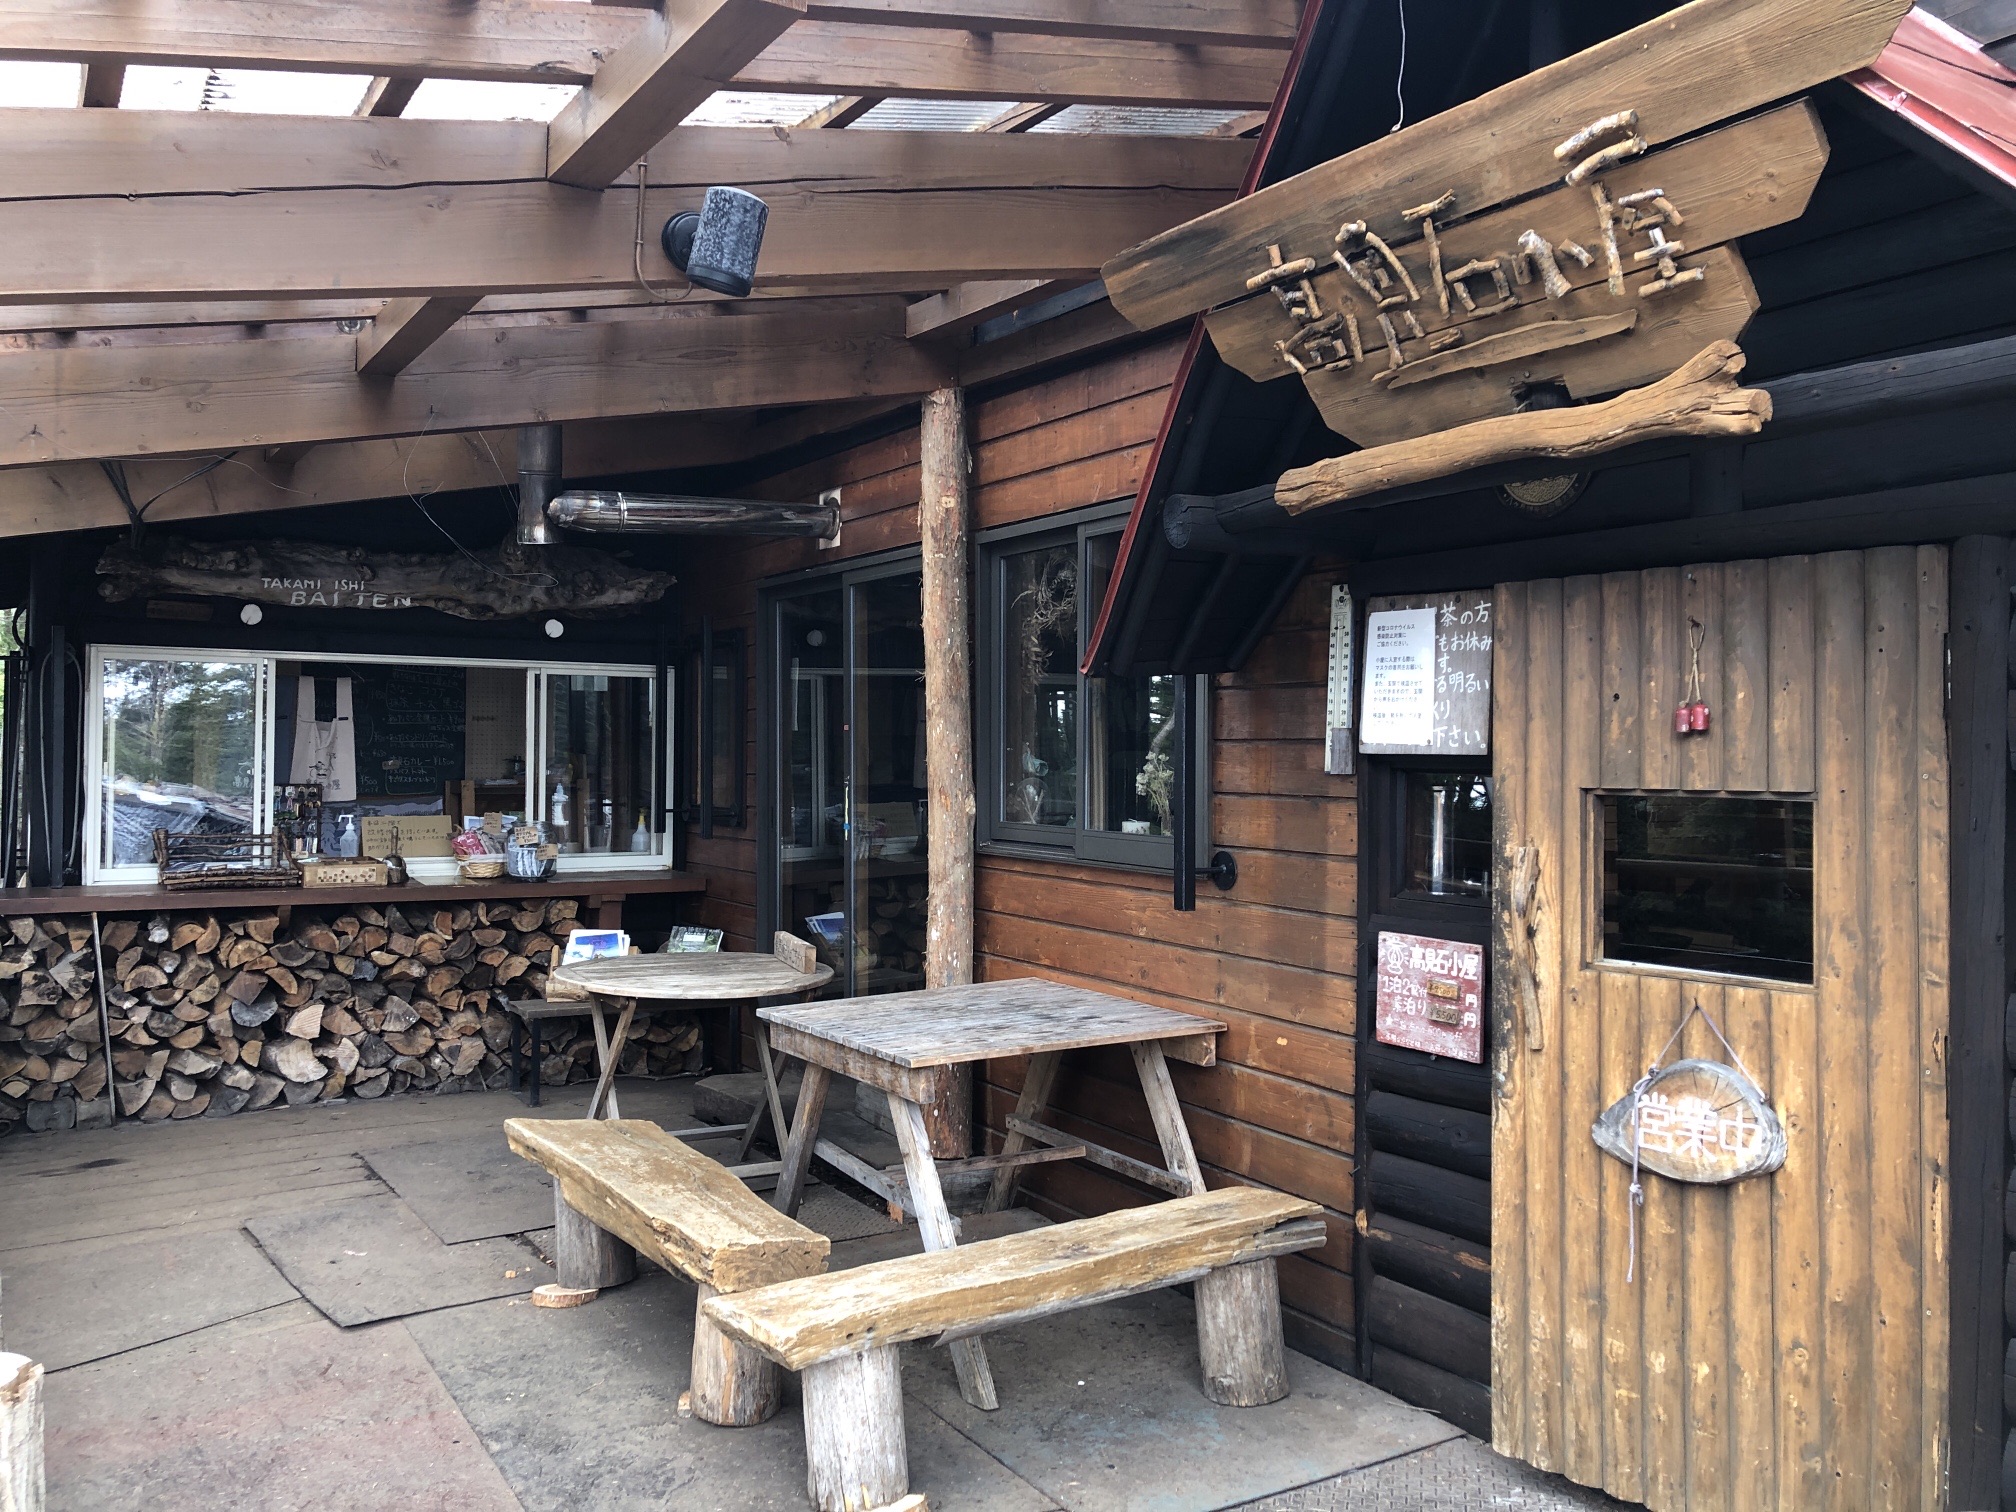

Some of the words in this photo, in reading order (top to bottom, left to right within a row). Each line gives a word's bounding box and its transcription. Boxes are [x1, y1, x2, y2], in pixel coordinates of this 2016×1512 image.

[1246, 108, 1706, 375] 高見石小屋
[262, 577, 321, 590] TAKAMI
[334, 578, 365, 591] ISHI
[290, 591, 340, 607] BAI
[352, 592, 413, 608] TEN
[1440, 600, 1492, 627] 茶の方
[1435, 631, 1493, 652] もお休み
[1434, 671, 1489, 694] る明るい
[1433, 726, 1487, 749] 下さい。
[1409, 944, 1479, 981] 高見石小屋
[1392, 995, 1427, 1017] 素泊り
[1463, 1011, 1477, 1029] 円
[1465, 993, 1478, 1008] 円
[1631, 1091, 1763, 1166] 営業中
